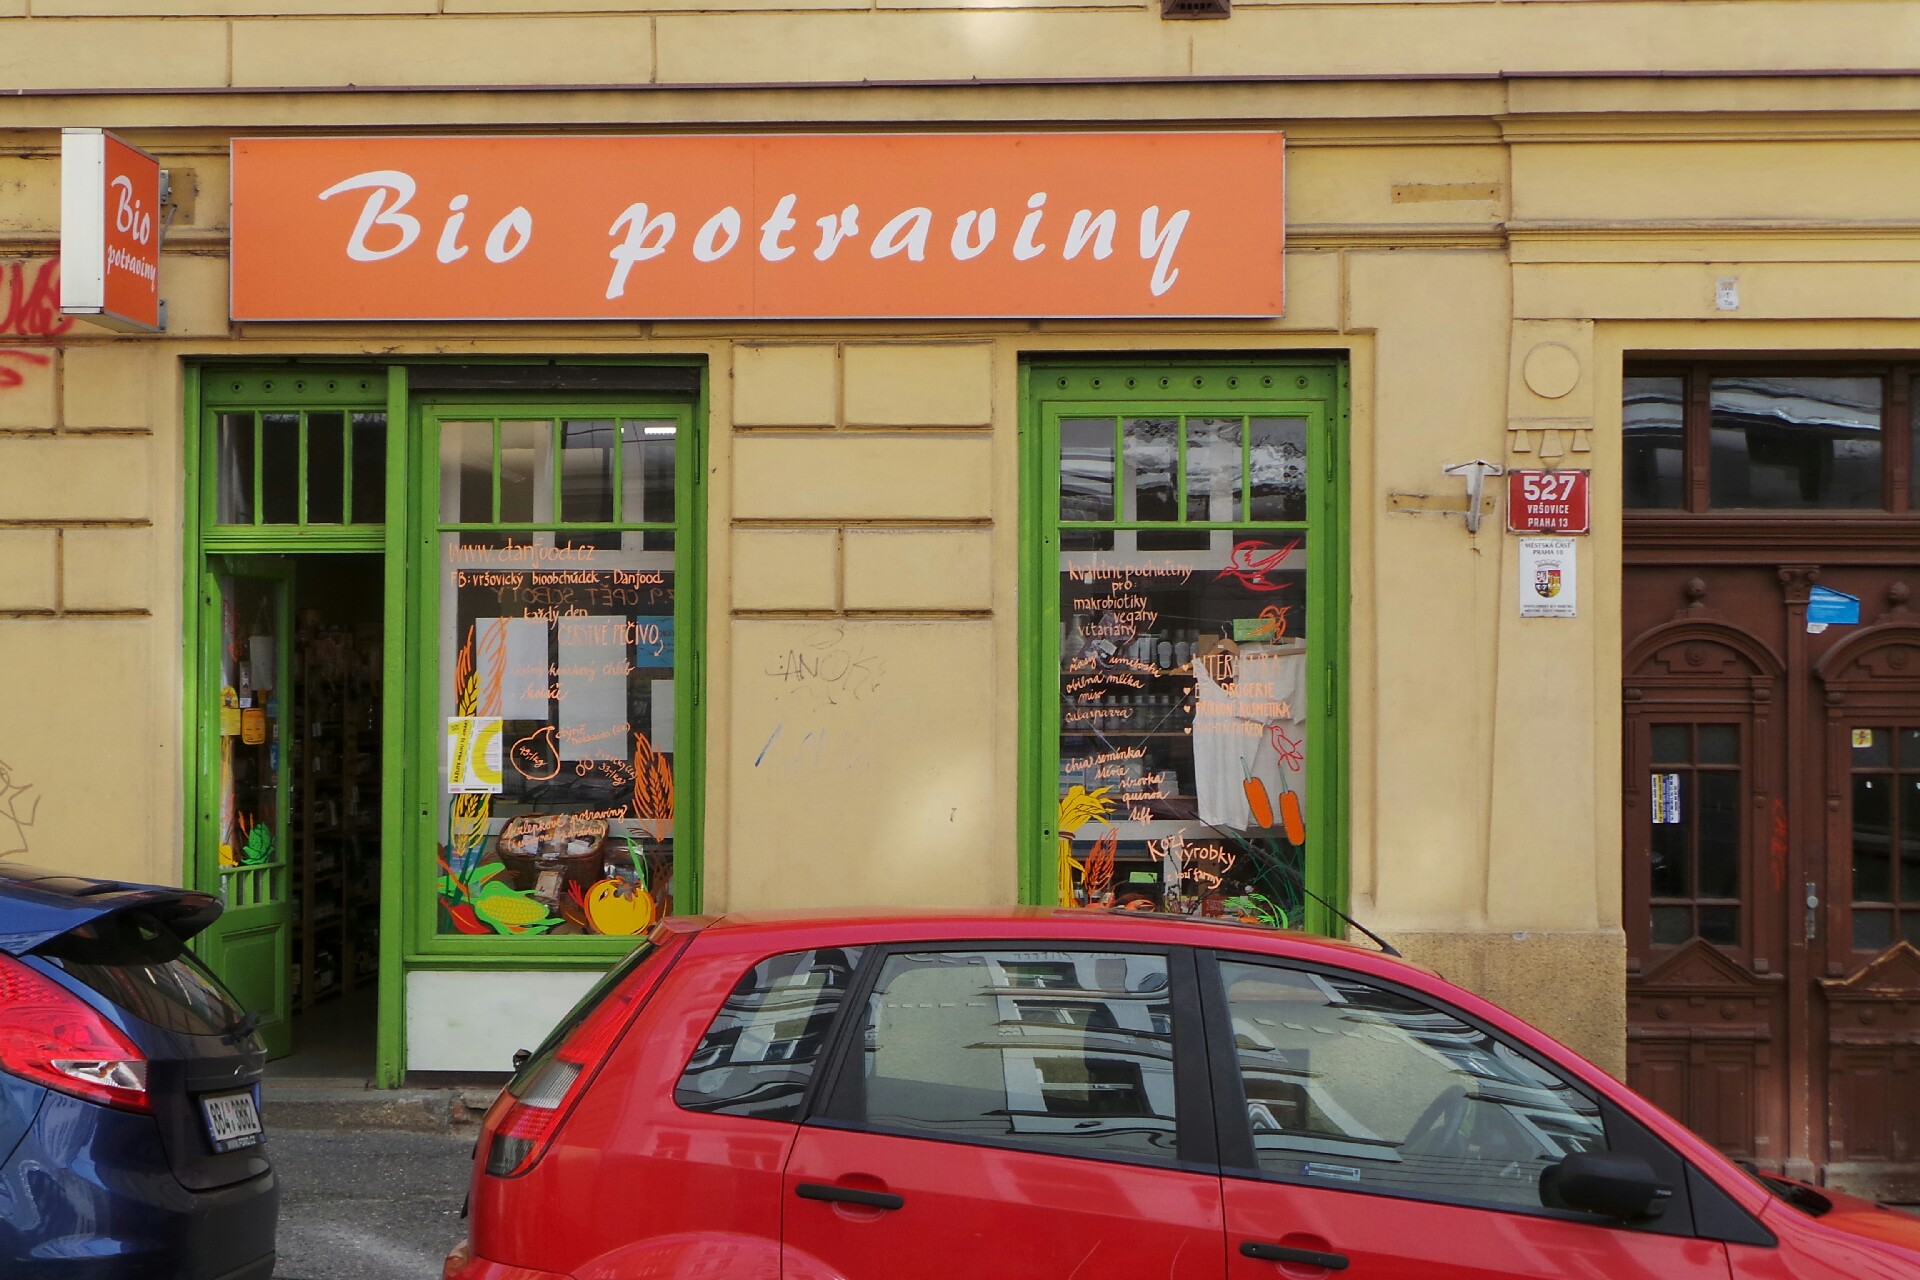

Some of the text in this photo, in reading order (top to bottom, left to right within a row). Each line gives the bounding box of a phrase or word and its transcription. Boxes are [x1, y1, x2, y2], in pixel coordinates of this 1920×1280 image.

[111, 175, 150, 245] Bio
[318, 169, 1190, 299] Bio potraviny
[107, 244, 156, 293] potraviny
[1523, 474, 1575, 501] 527
[1527, 502, 1569, 514] VRŠOVICE
[1528, 518, 1568, 528] PRAHA 13
[449, 537, 596, 568] www.danfood.cz
[613, 568, 665, 589] Danfood
[524, 605, 588, 630] každý den
[1073, 596, 1148, 615] makrobiotiky
[1113, 611, 1158, 630] vegany
[1066, 670, 1105, 693] obilná
[1094, 746, 1148, 765] semínka
[570, 804, 628, 832] potraviny
[1175, 842, 1236, 874] výrobky
[1193, 867, 1223, 890] farmy
